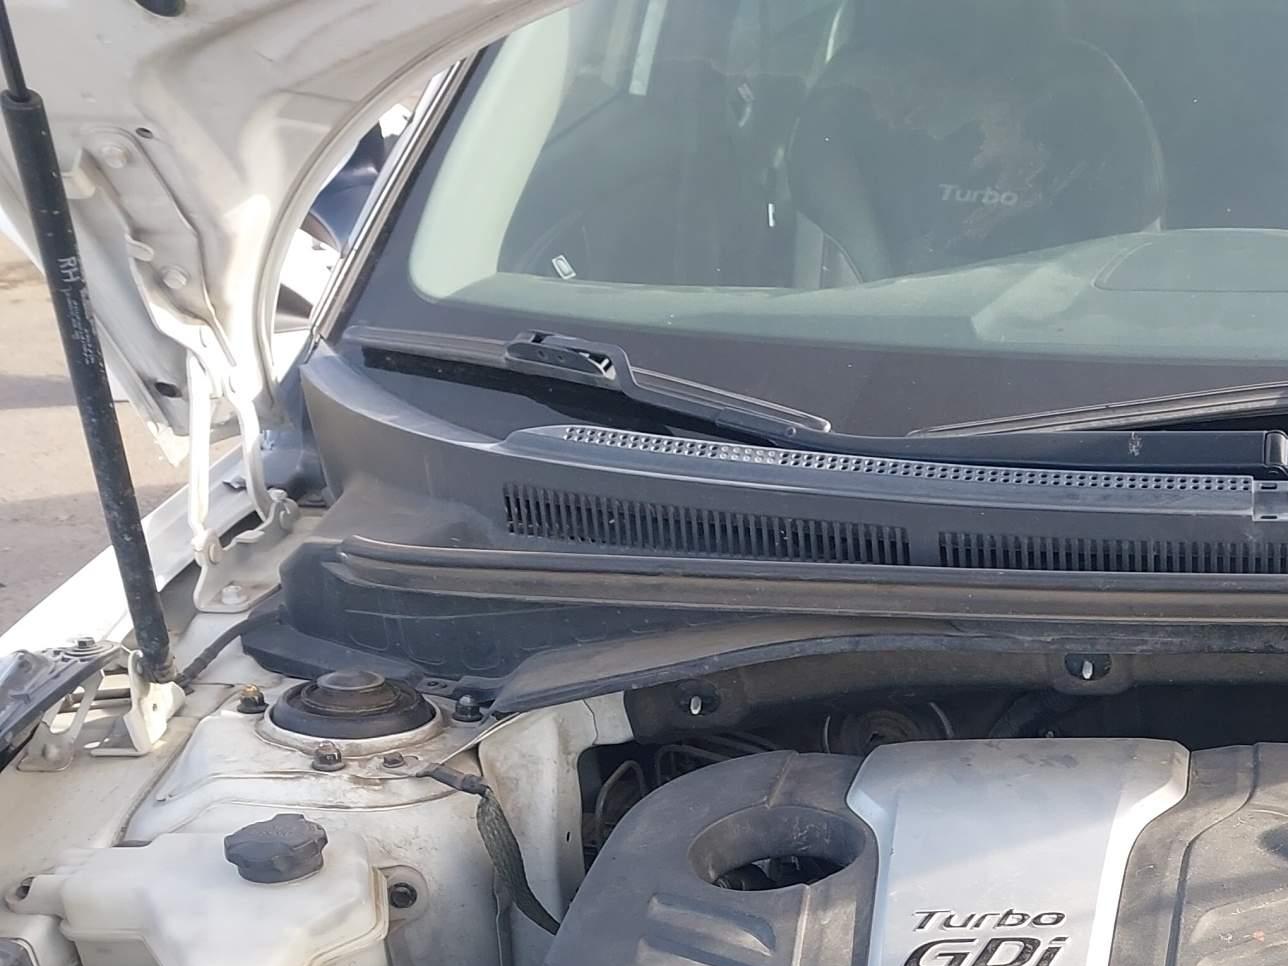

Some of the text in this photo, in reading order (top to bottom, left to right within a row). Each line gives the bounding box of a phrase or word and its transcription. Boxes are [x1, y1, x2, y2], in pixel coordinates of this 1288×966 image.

[937, 183, 1018, 206] Turbo
[58, 256, 80, 282] RH
[912, 908, 1067, 932] Turbo
